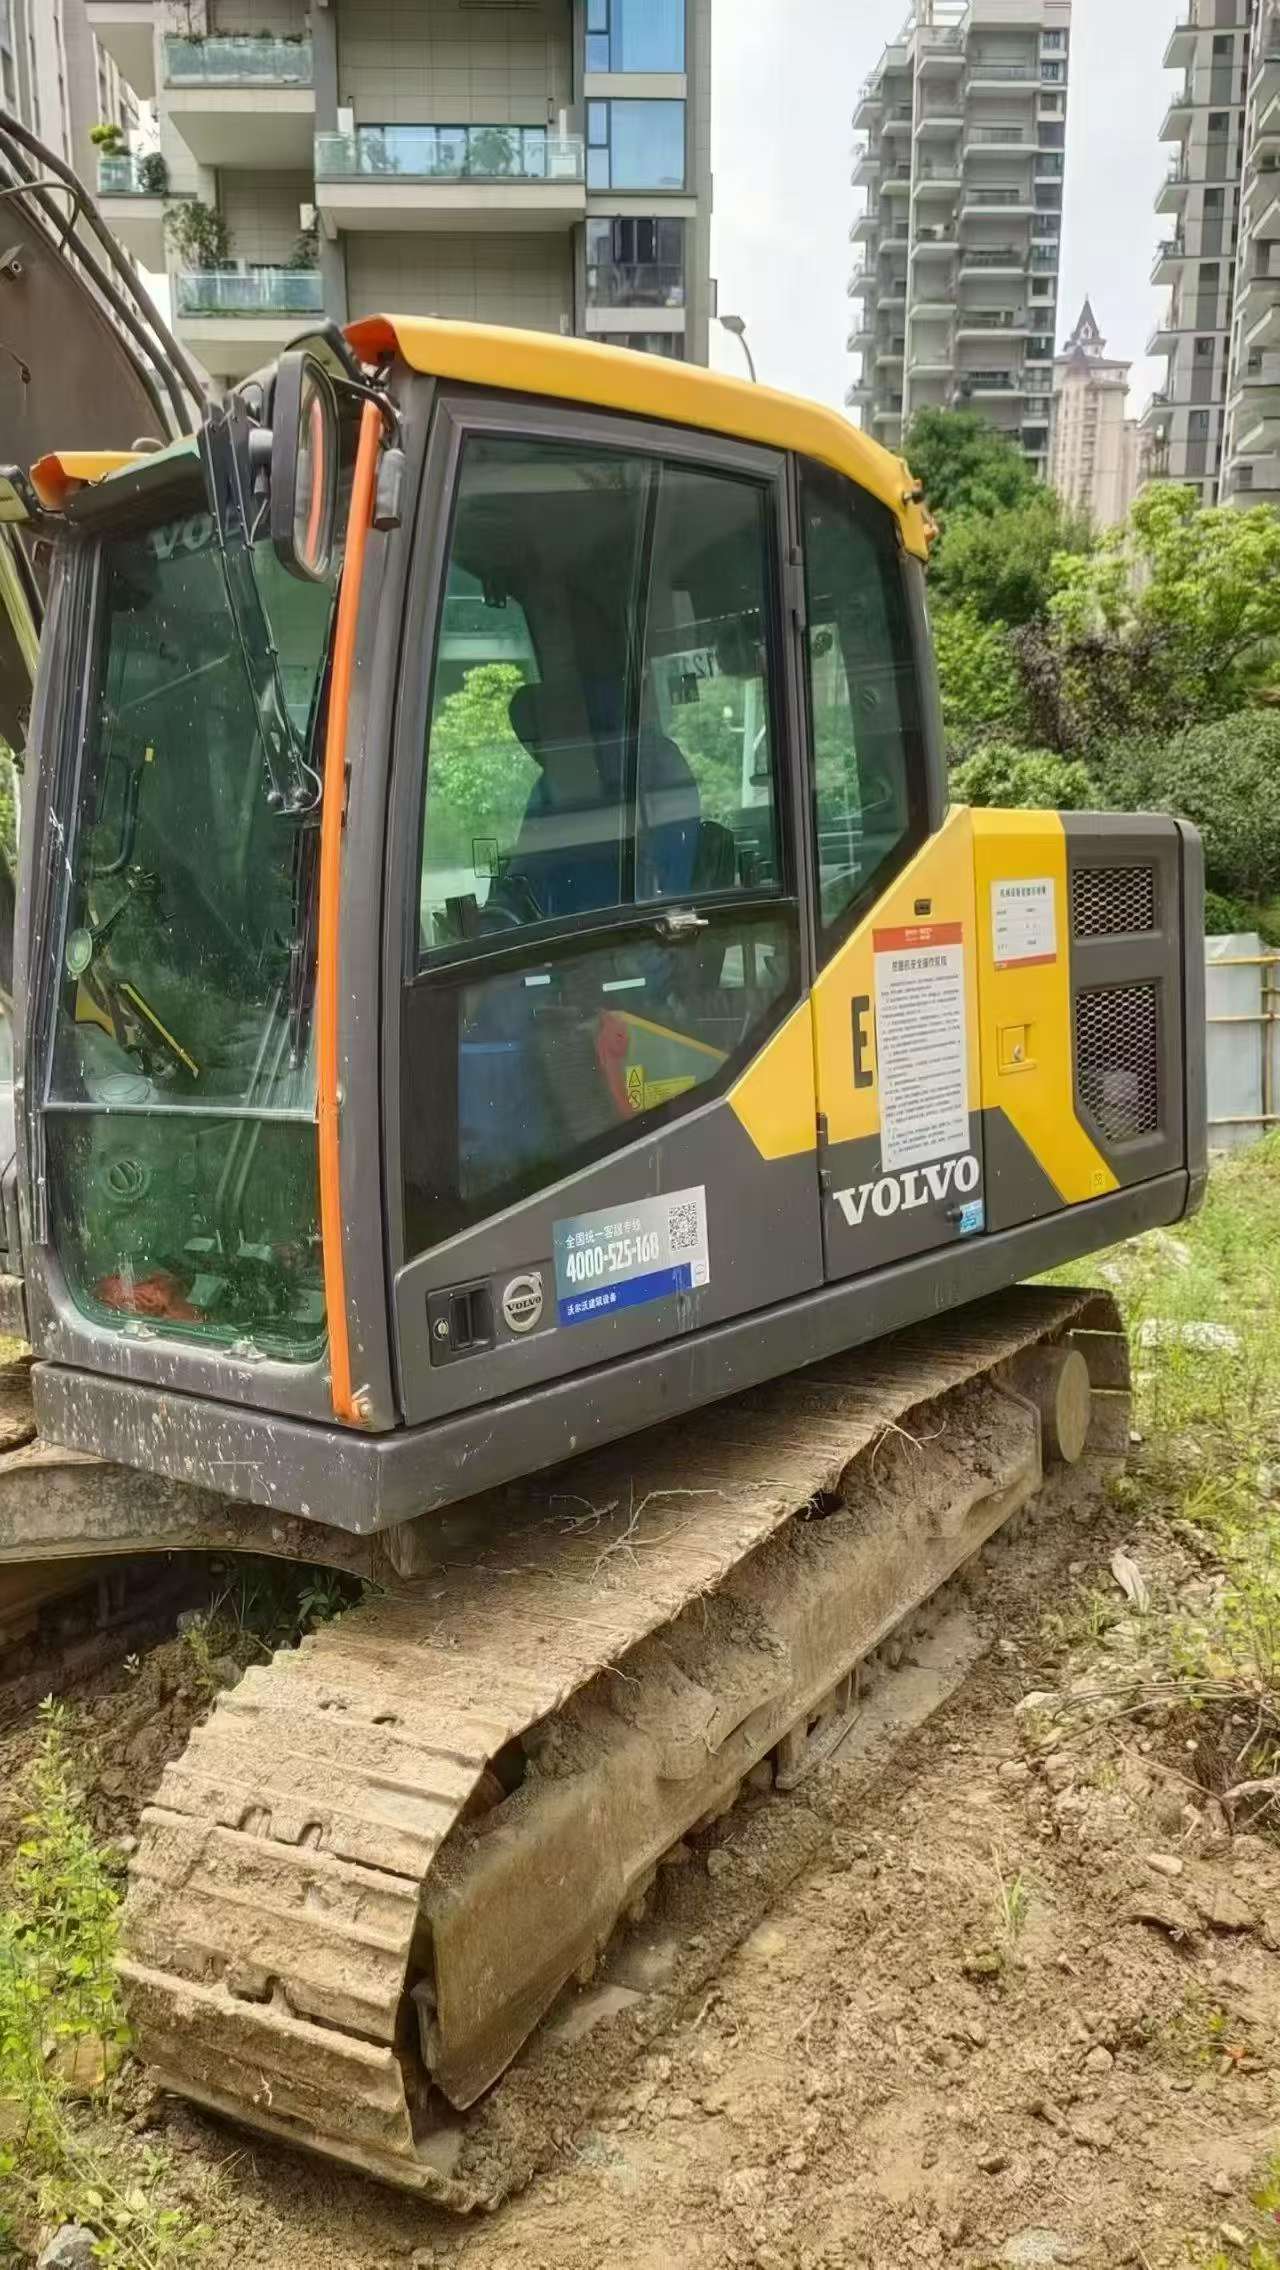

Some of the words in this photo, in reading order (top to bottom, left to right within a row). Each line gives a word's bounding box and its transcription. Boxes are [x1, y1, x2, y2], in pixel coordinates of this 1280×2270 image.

[147, 513, 214, 560] VO
[851, 995, 879, 1088] E
[833, 1155, 979, 1226] VOLVO
[566, 1232, 660, 1283] 4000-525-168
[506, 1296, 541, 1311] VOLVO
